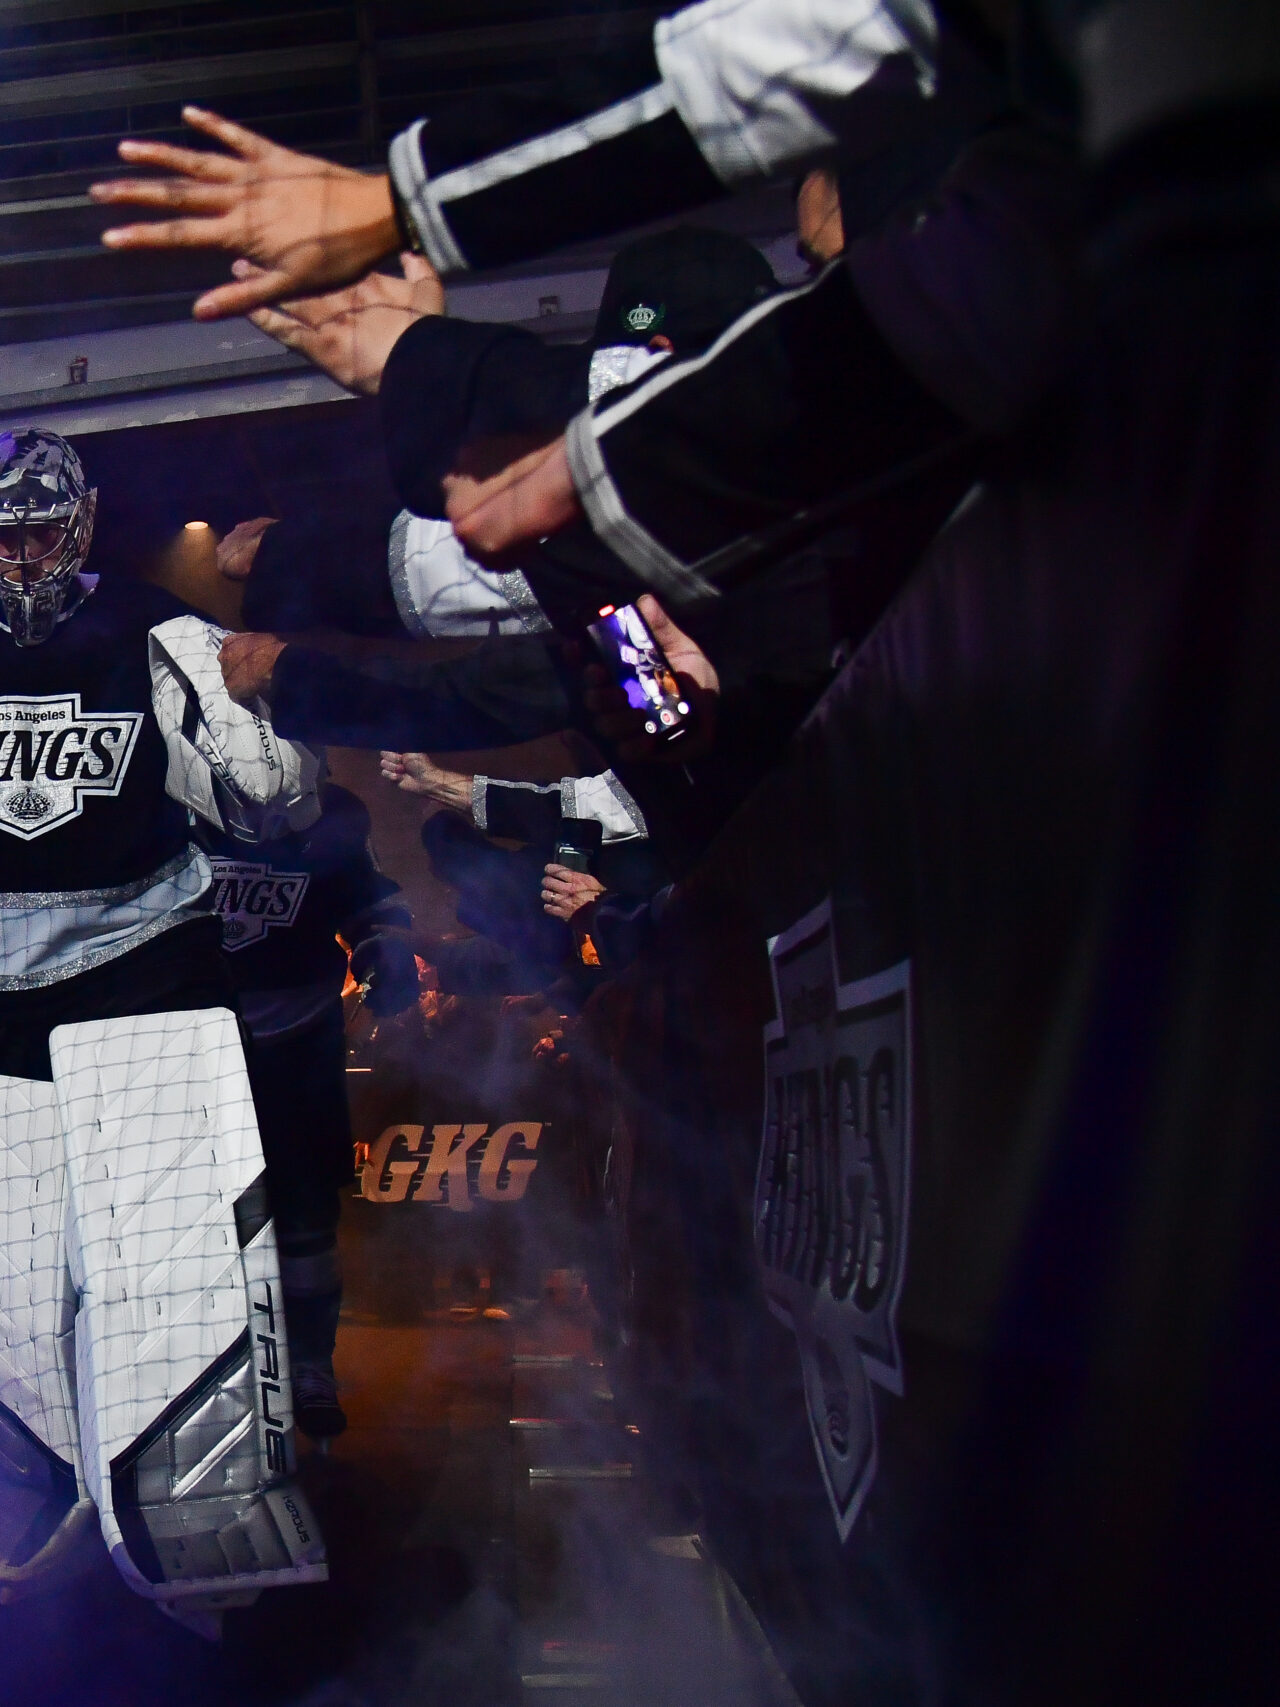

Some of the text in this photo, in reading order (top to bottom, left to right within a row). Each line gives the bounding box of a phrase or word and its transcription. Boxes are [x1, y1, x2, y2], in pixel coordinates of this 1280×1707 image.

[15, 709, 66, 724] Angeles
[360, 1121, 543, 1212] GKG
[253, 1281, 287, 1475] TRUE
